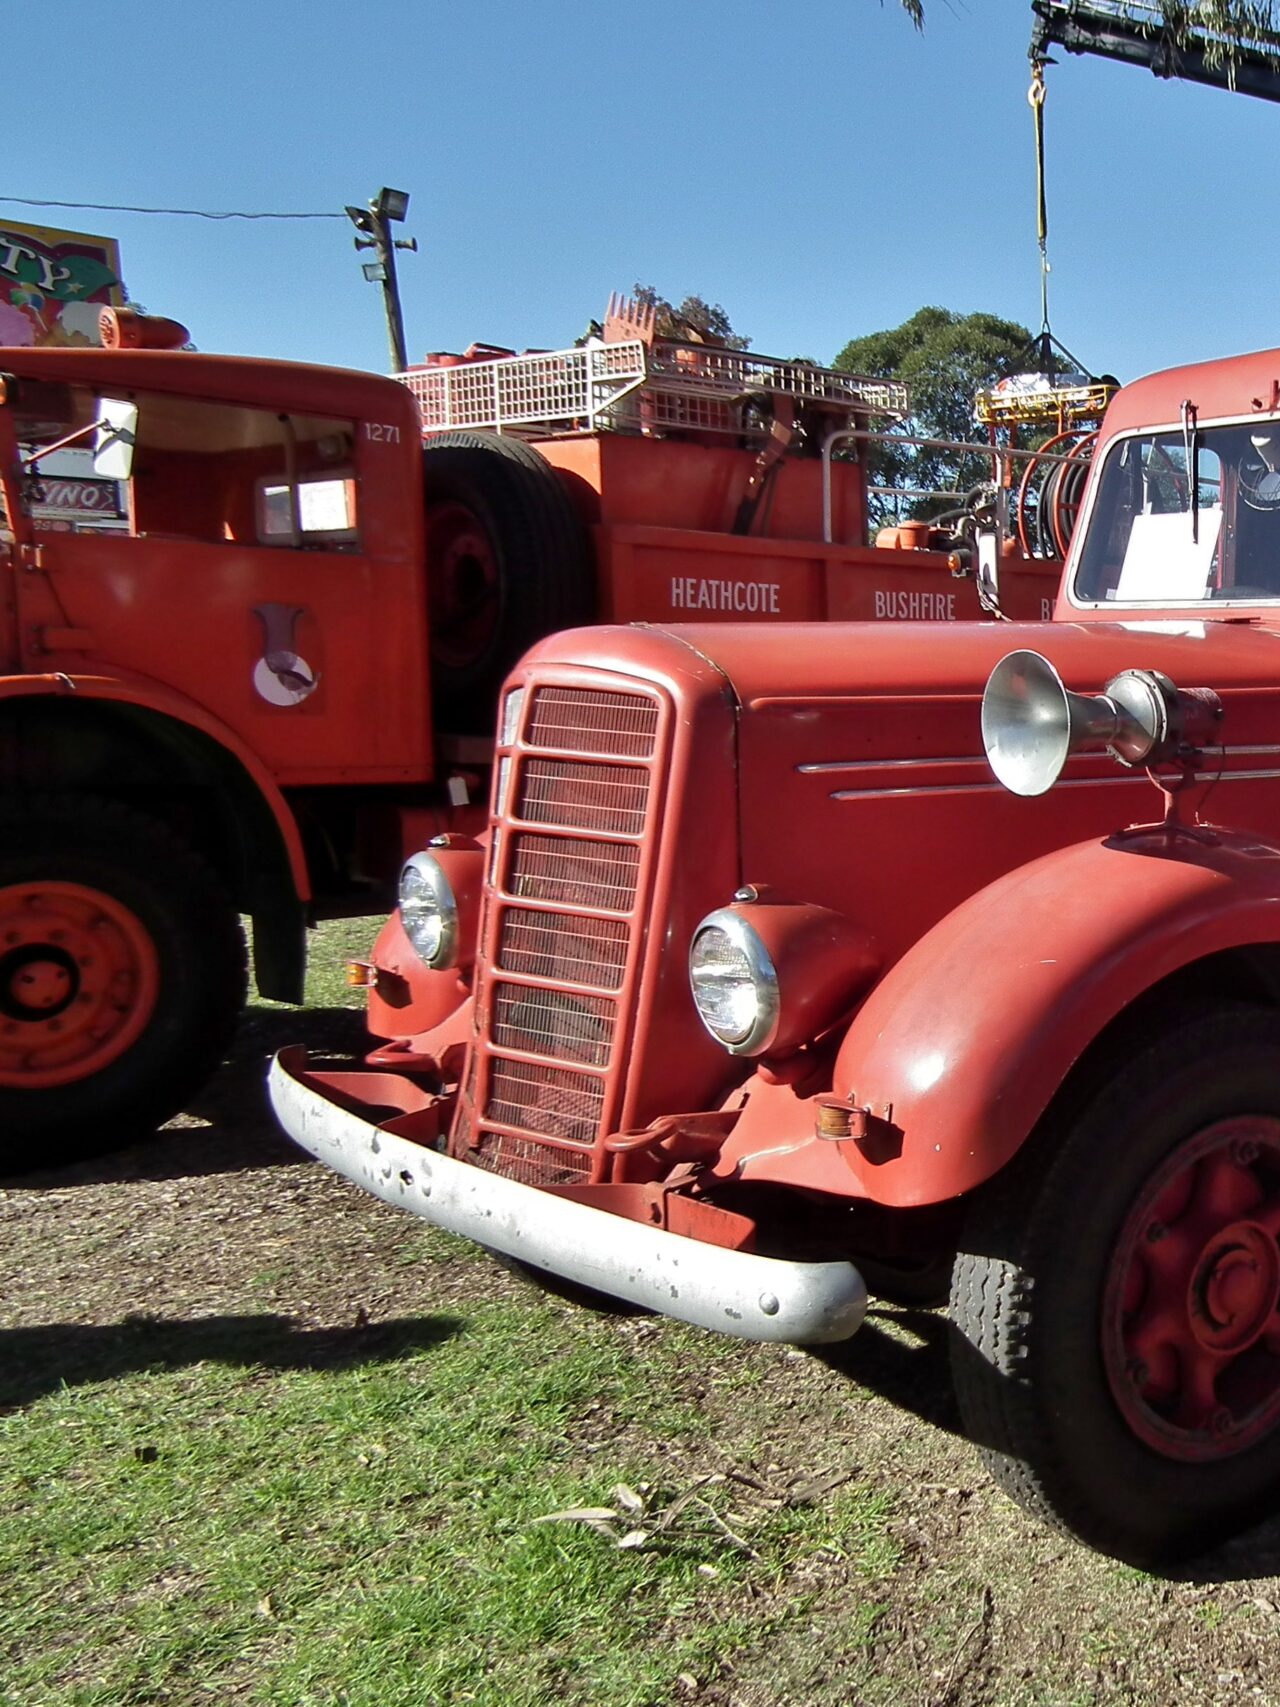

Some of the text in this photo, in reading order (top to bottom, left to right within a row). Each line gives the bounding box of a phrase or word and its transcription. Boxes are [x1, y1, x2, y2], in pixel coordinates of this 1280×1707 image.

[364, 422, 400, 444] 1271
[671, 577, 780, 613] HEATHCOTE
[875, 591, 955, 620] BUSHFIRE
